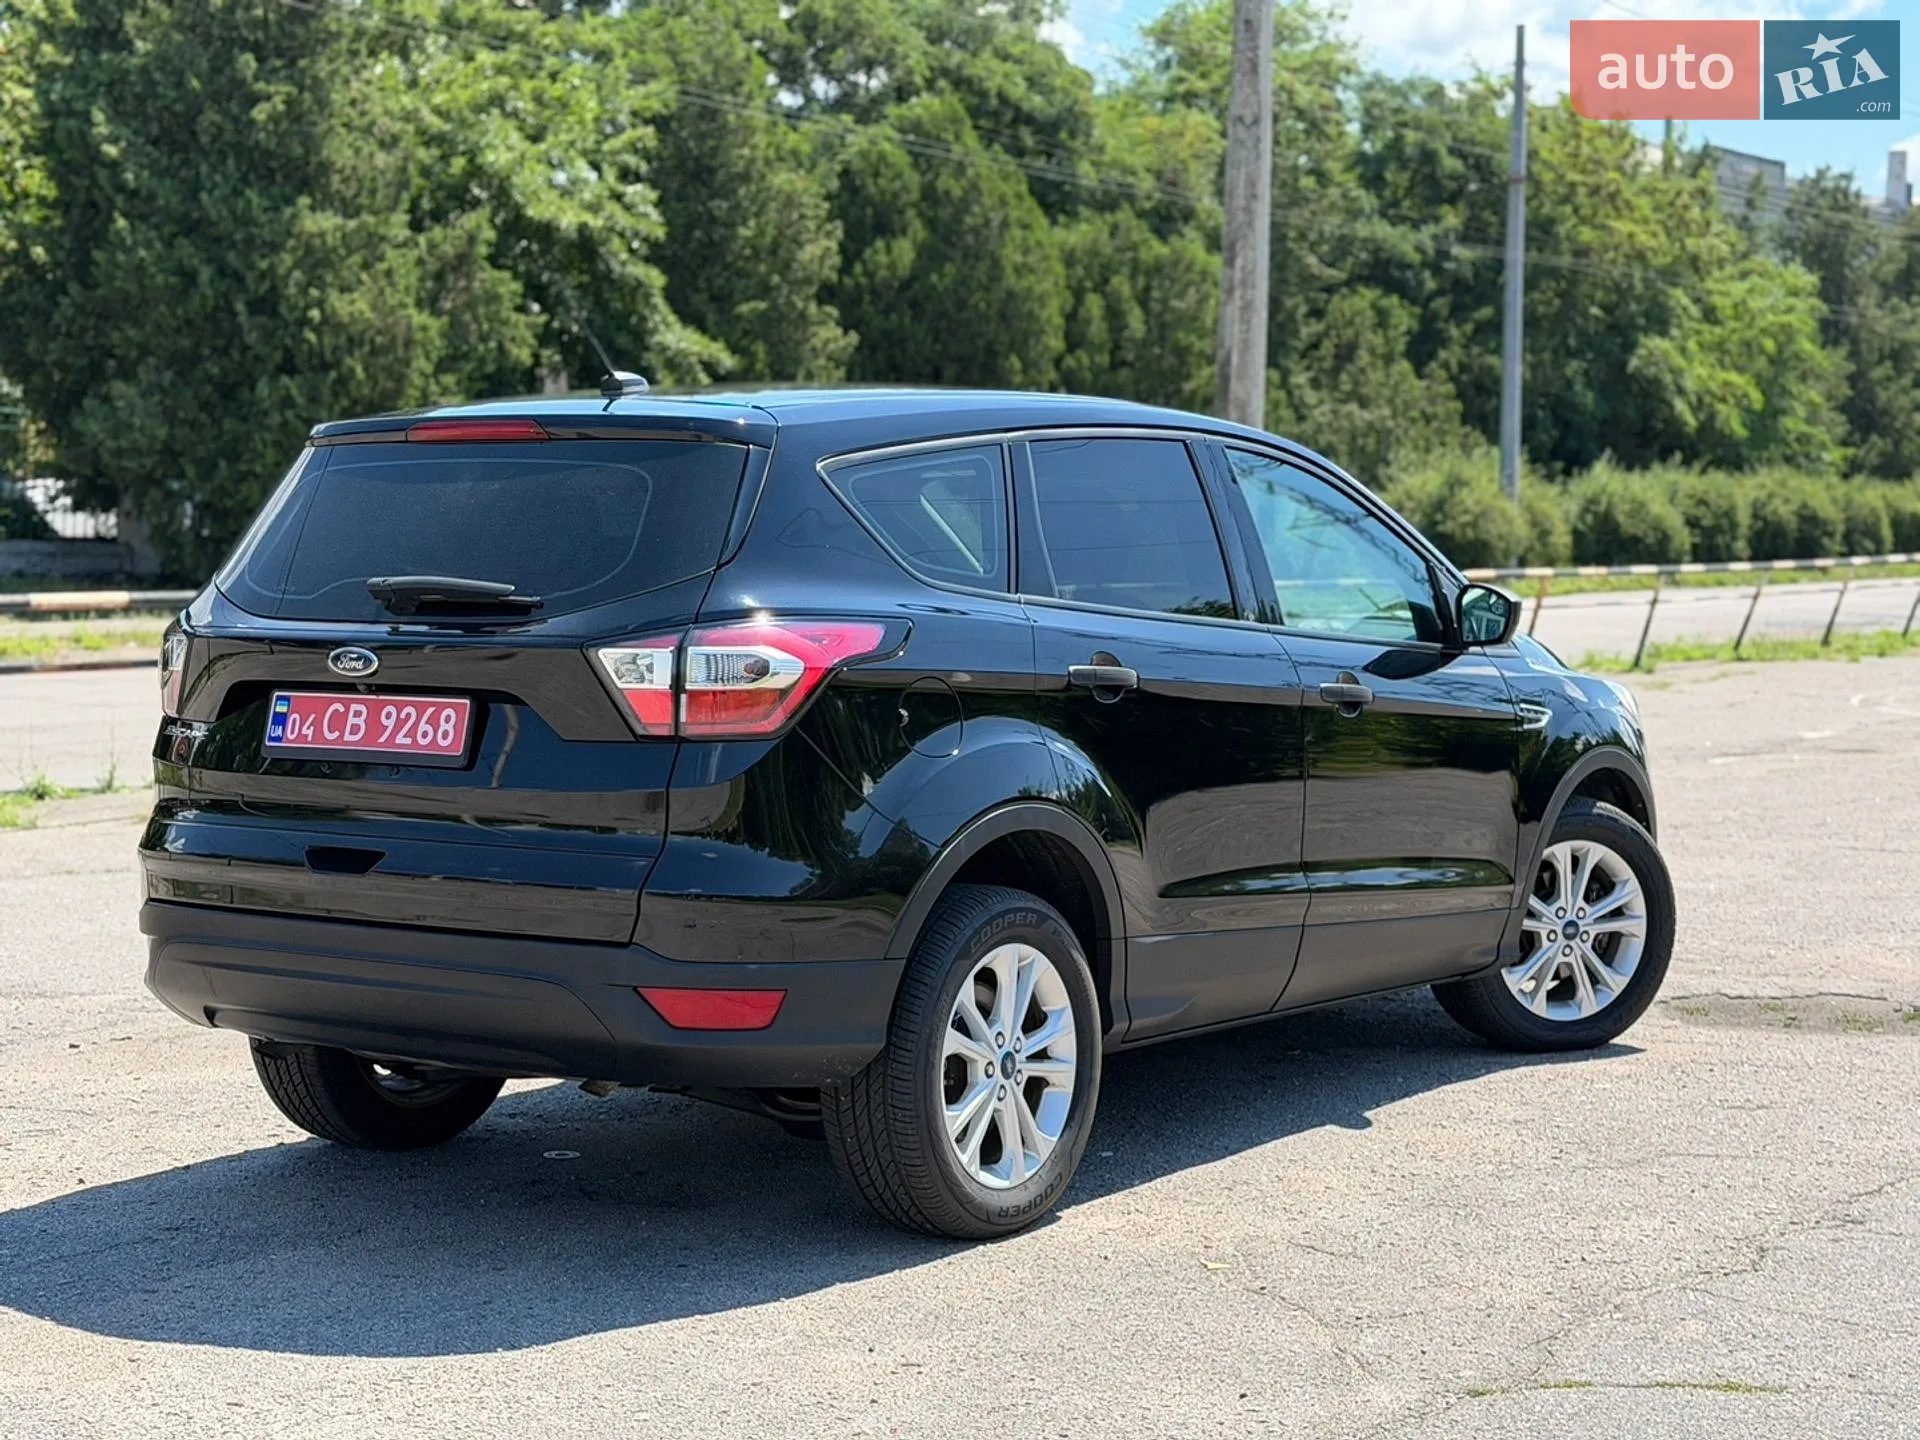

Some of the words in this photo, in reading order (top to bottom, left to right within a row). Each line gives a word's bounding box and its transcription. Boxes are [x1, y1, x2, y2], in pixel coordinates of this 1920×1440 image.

[337, 653, 365, 670] Ford
[270, 725, 283, 738] UA
[286, 713, 316, 741] 04
[322, 702, 368, 742] CB
[377, 704, 457, 747] 9268
[970, 911, 1038, 953] COOPER
[998, 1171, 1063, 1218] COOPER
